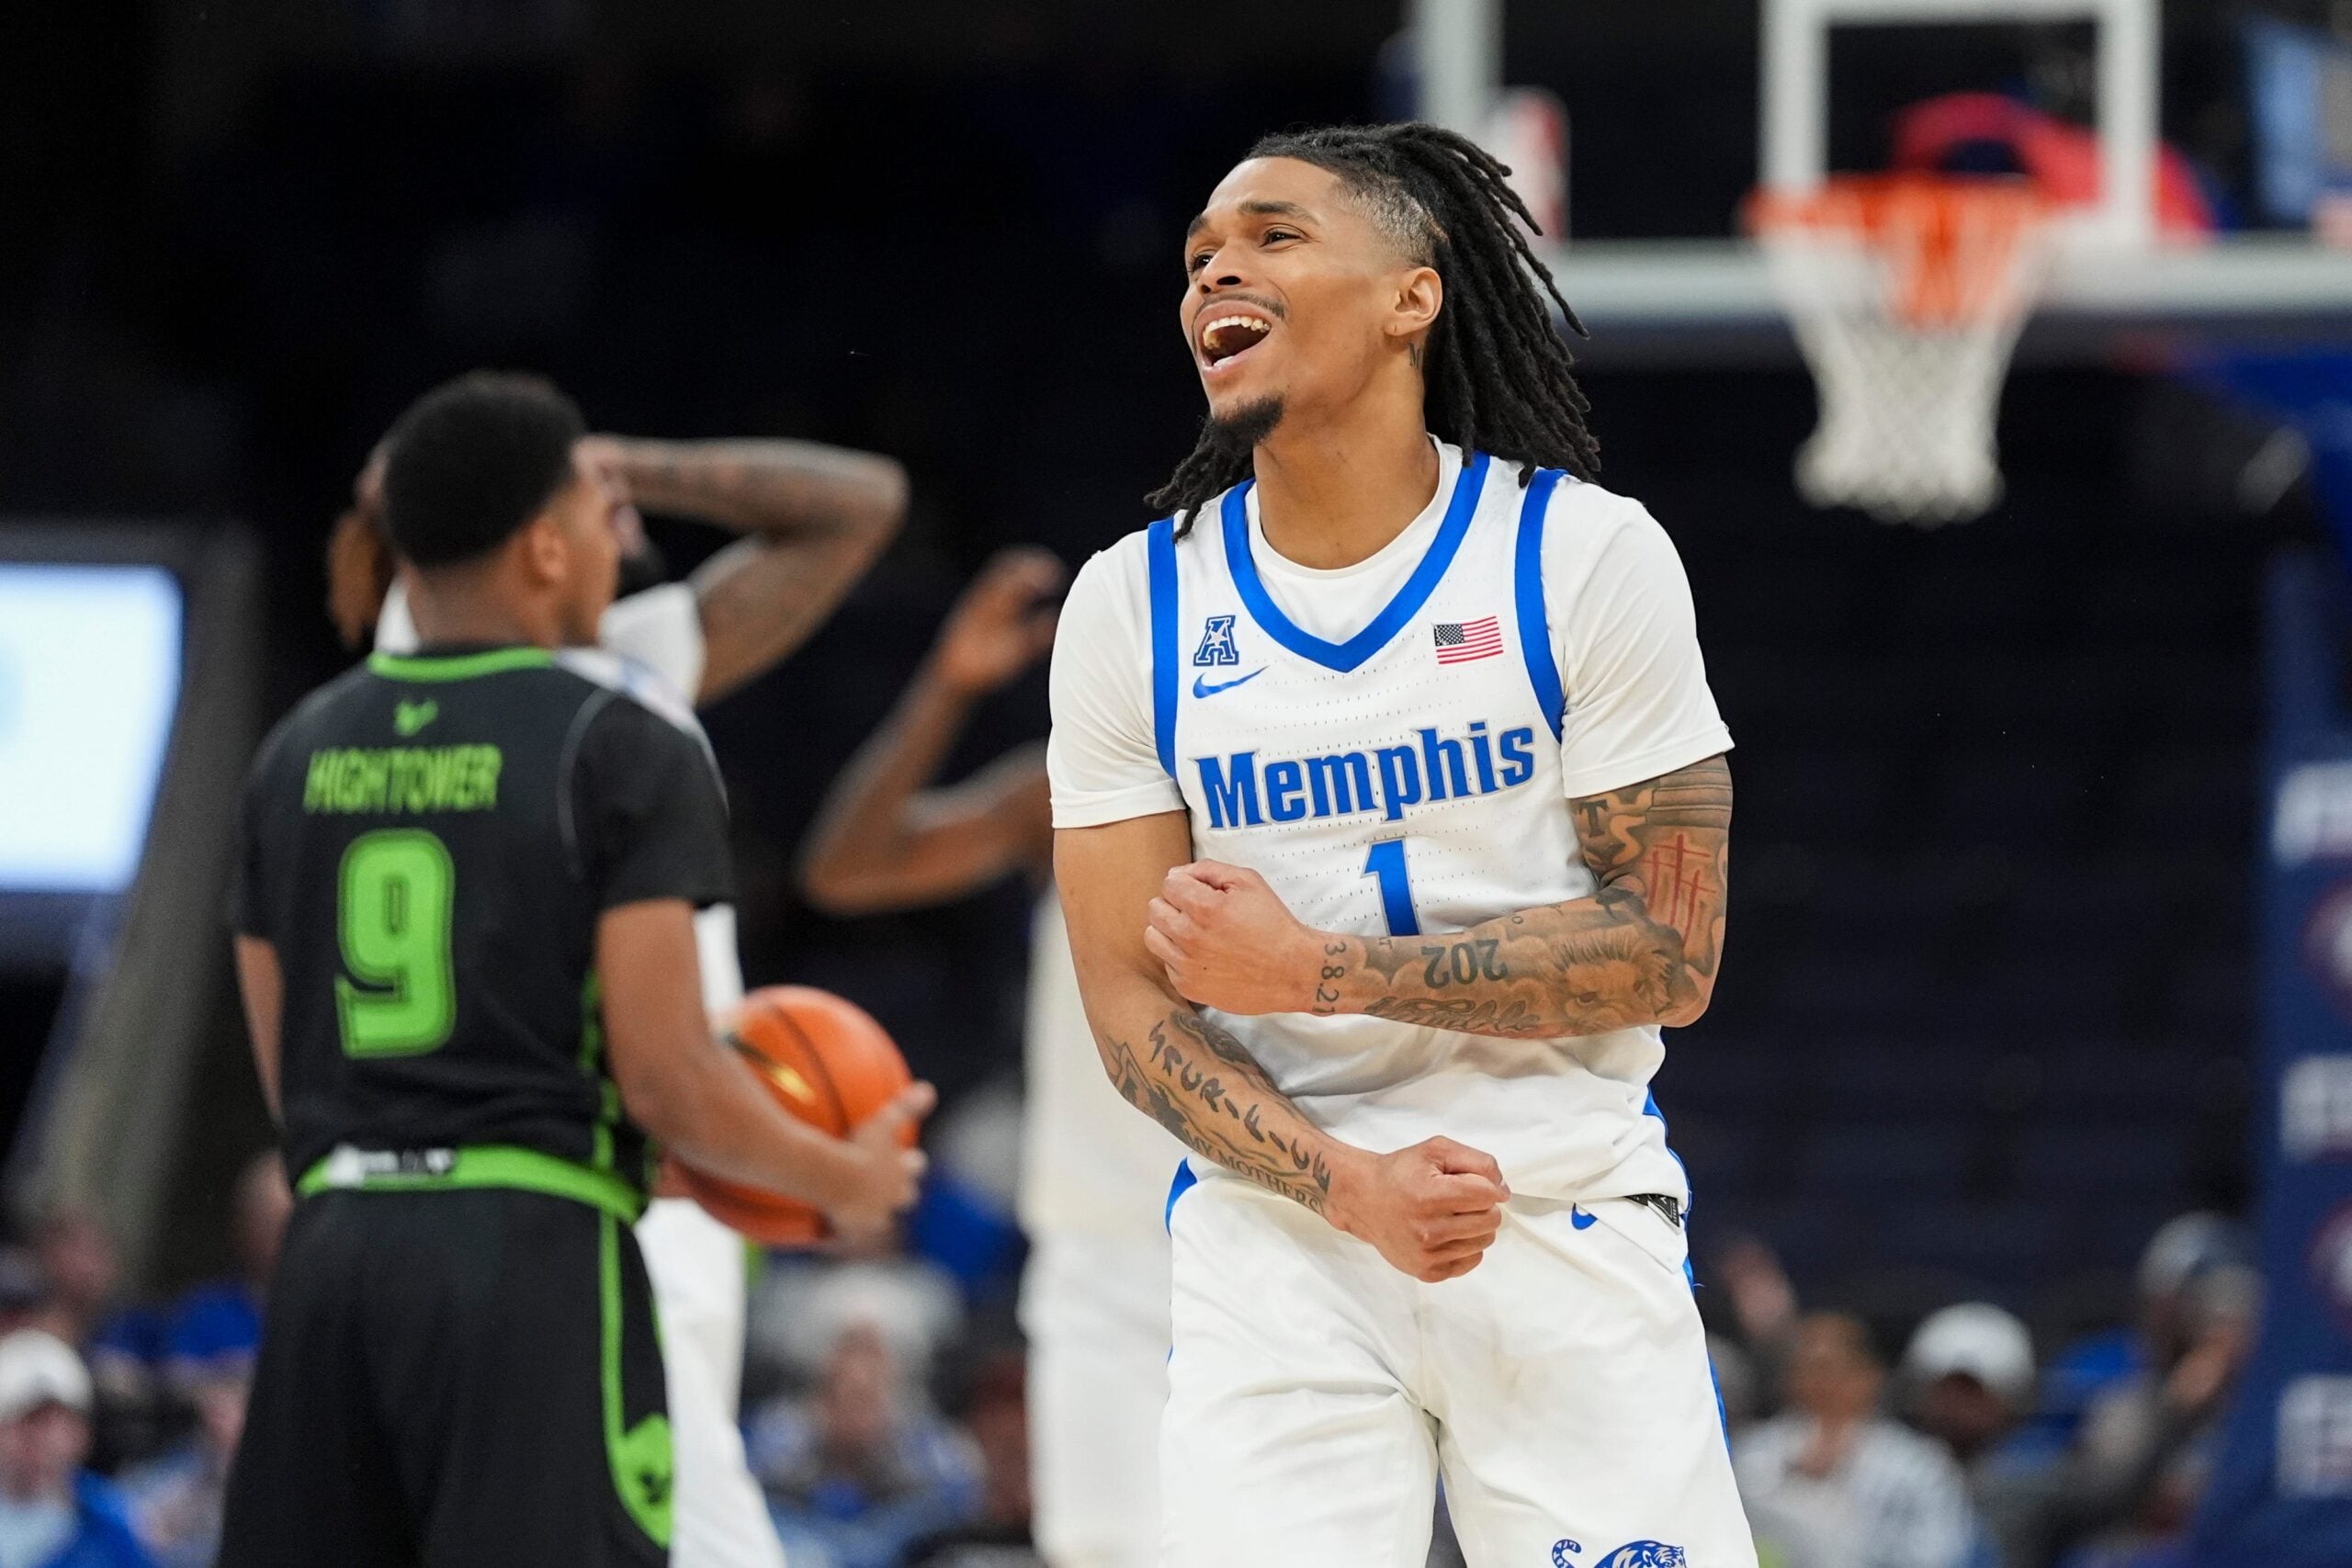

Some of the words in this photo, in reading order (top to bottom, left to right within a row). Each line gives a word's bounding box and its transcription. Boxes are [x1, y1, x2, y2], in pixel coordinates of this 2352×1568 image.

[303, 743, 503, 814] HIGHTOWER
[1188, 718, 1536, 831] Memphis
[1359, 837, 1423, 937] 1
[334, 827, 457, 1060] 9
[1420, 939, 1509, 989] 202
